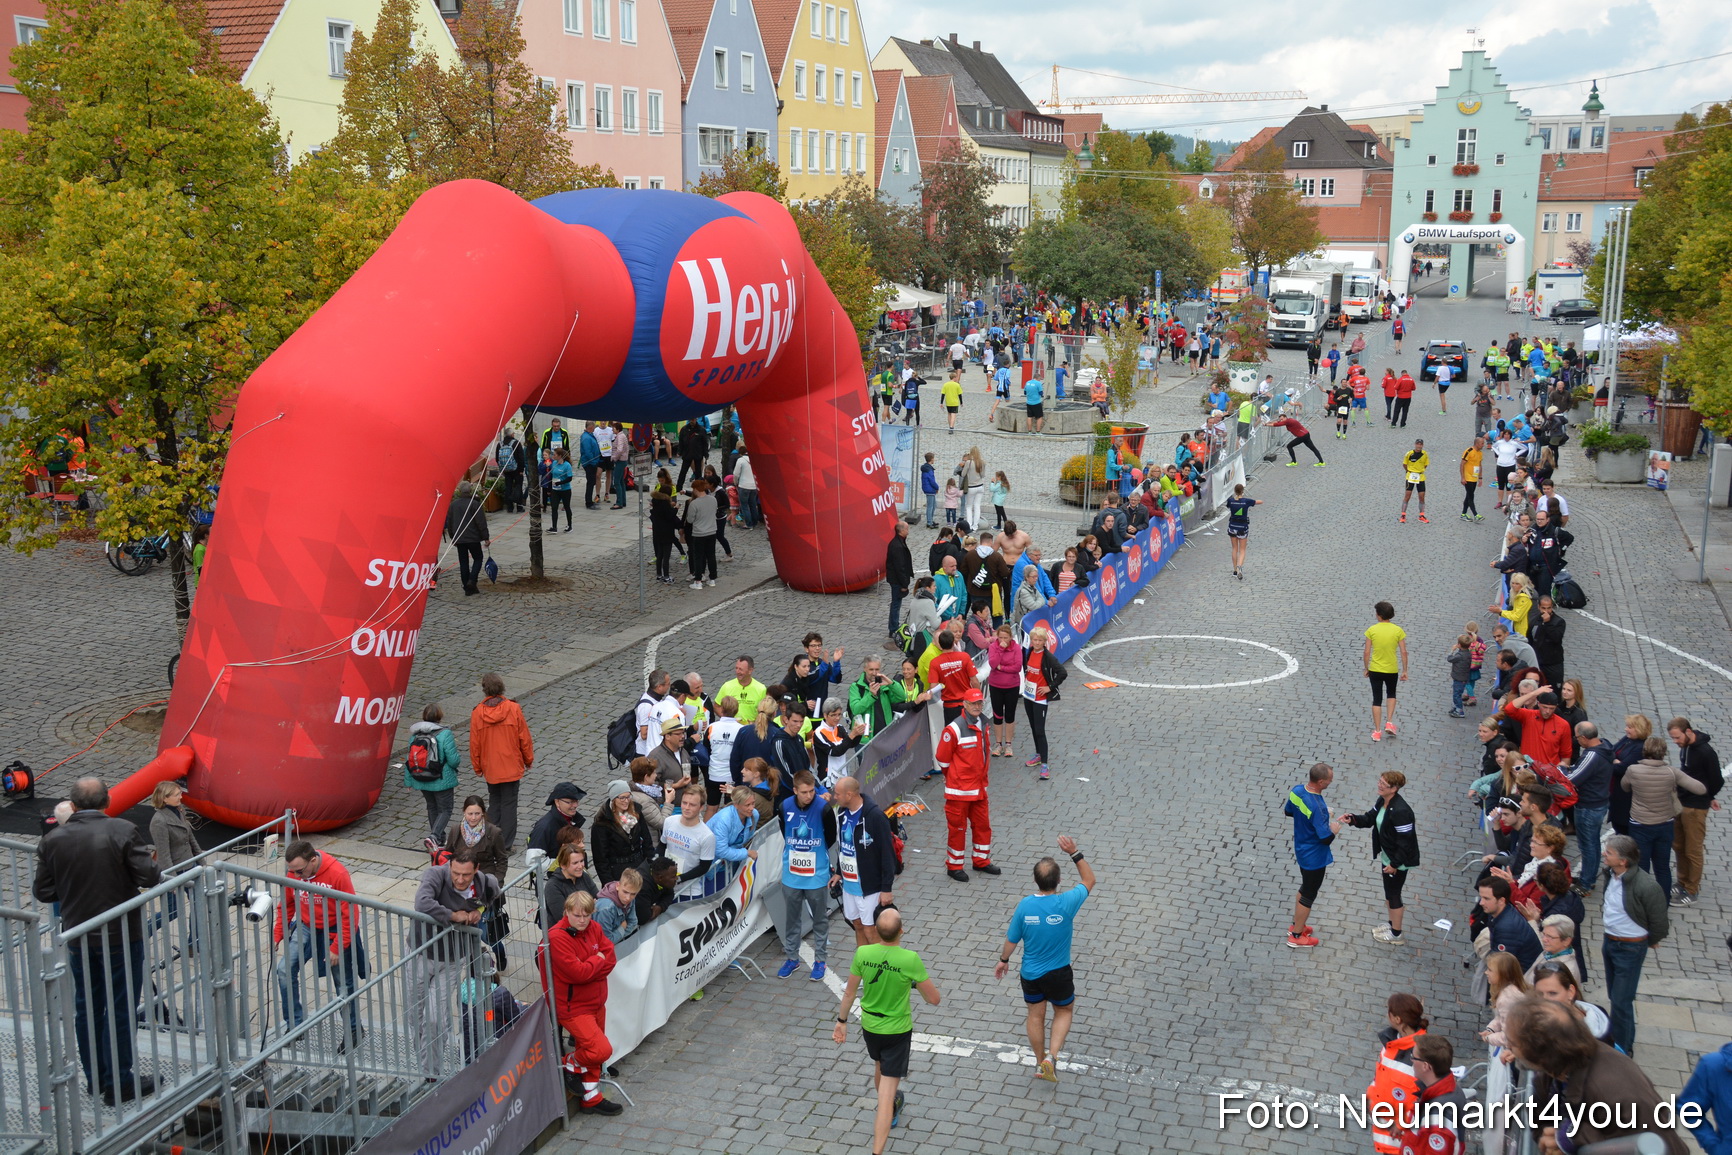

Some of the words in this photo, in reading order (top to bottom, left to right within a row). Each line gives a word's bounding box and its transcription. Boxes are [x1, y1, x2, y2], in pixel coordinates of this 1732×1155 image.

[1418, 228, 1447, 237] BMW
[1450, 229, 1501, 239] Laufsport
[687, 359, 765, 388] SPORTS
[1070, 598, 1091, 627] Hervis
[786, 812, 795, 822] 7
[674, 832, 692, 845] BANK
[792, 858, 812, 867] 8003
[675, 946, 717, 984] stadtwerke
[716, 916, 749, 952] neumarkt
